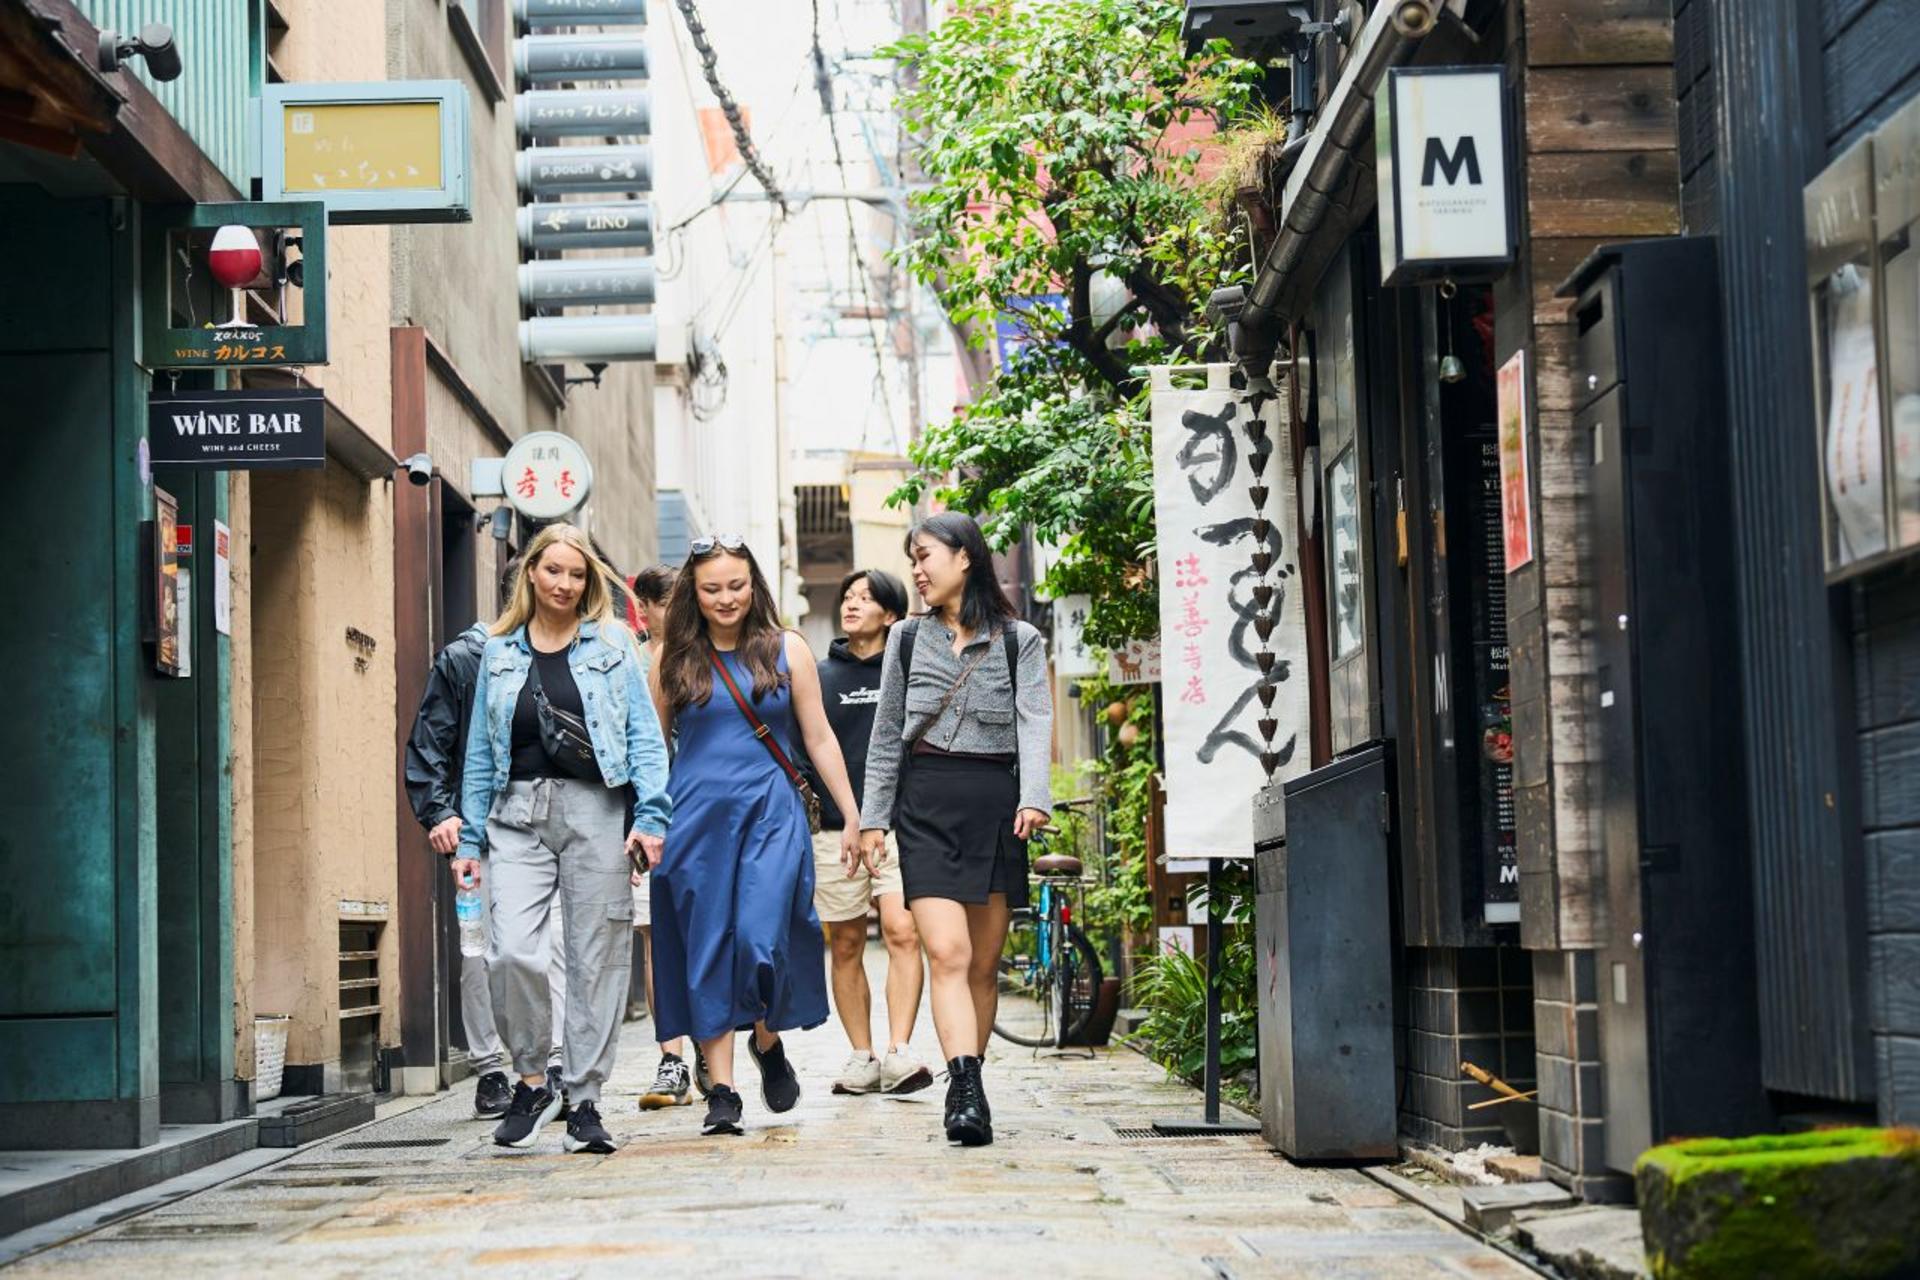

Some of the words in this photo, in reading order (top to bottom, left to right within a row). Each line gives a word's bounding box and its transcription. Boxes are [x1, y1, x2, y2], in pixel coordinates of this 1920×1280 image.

[581, 103, 638, 117] フレンド
[1421, 136, 1482, 186] M
[540, 163, 594, 178] p.pouch
[585, 216, 629, 230] LINO
[175, 349, 209, 359] WINE
[214, 344, 286, 361] カルコス
[172, 410, 240, 436] WINE
[248, 413, 302, 435] BAR
[202, 444, 225, 452] WINE
[228, 444, 244, 452] and
[247, 443, 281, 452] CHEESE
[1499, 865, 1520, 884] M
